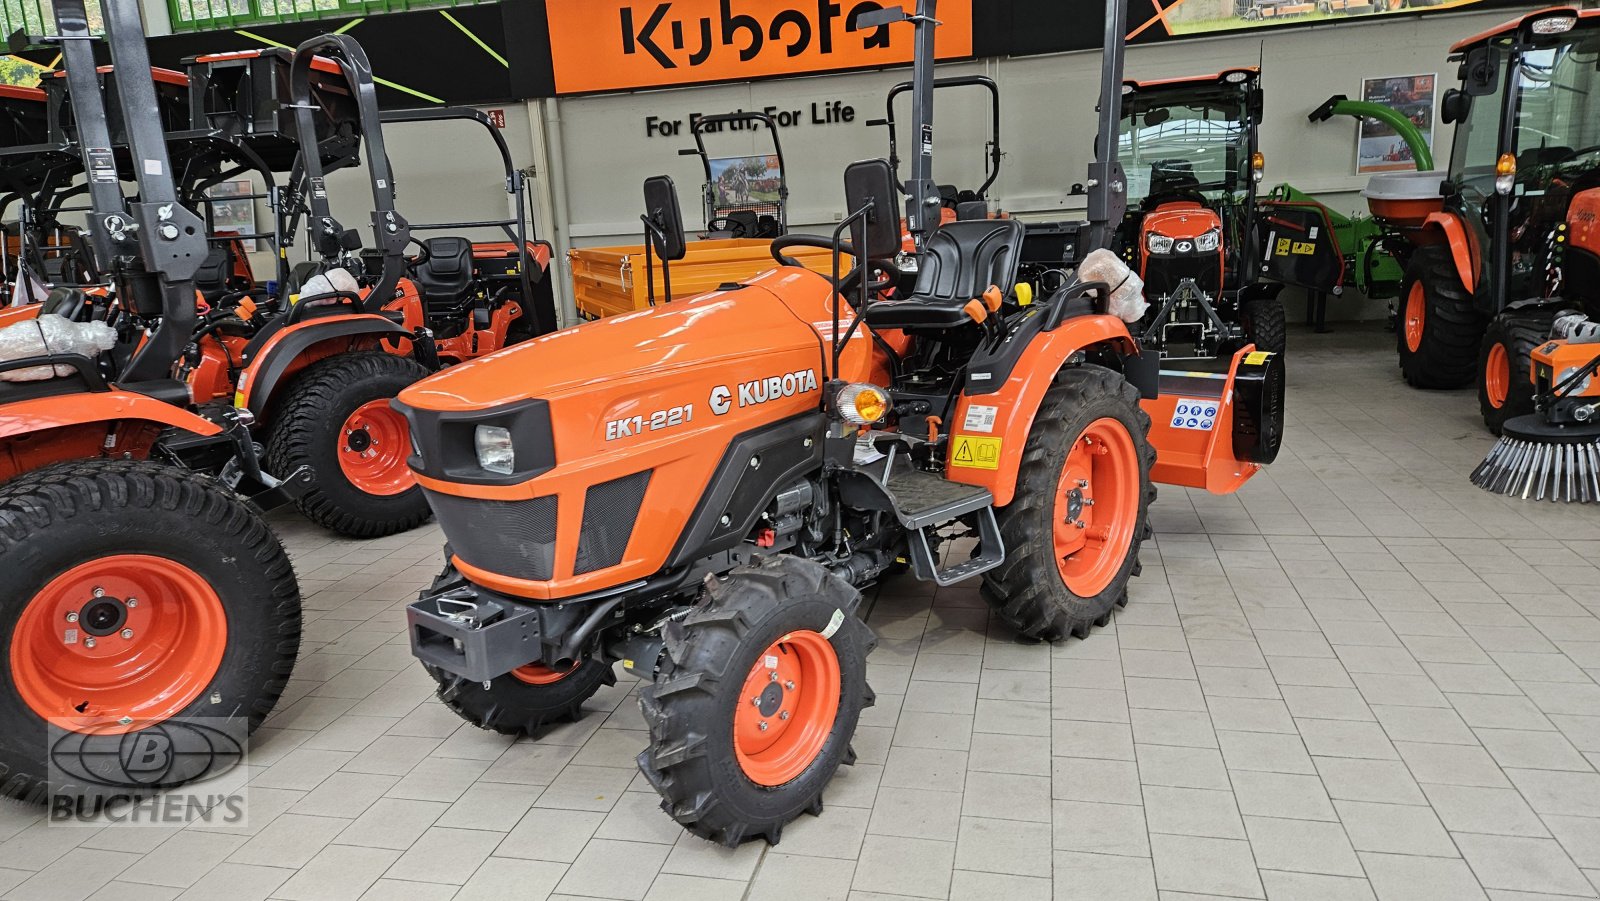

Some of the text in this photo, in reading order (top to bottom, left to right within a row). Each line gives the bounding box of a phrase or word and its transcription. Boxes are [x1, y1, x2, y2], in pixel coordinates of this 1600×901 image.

[619, 0, 891, 69] Kubota
[645, 116, 682, 138] For
[763, 106, 802, 128] For
[811, 101, 855, 125] Life
[738, 368, 818, 407] KUBOTA
[605, 403, 693, 441] EK1-221
